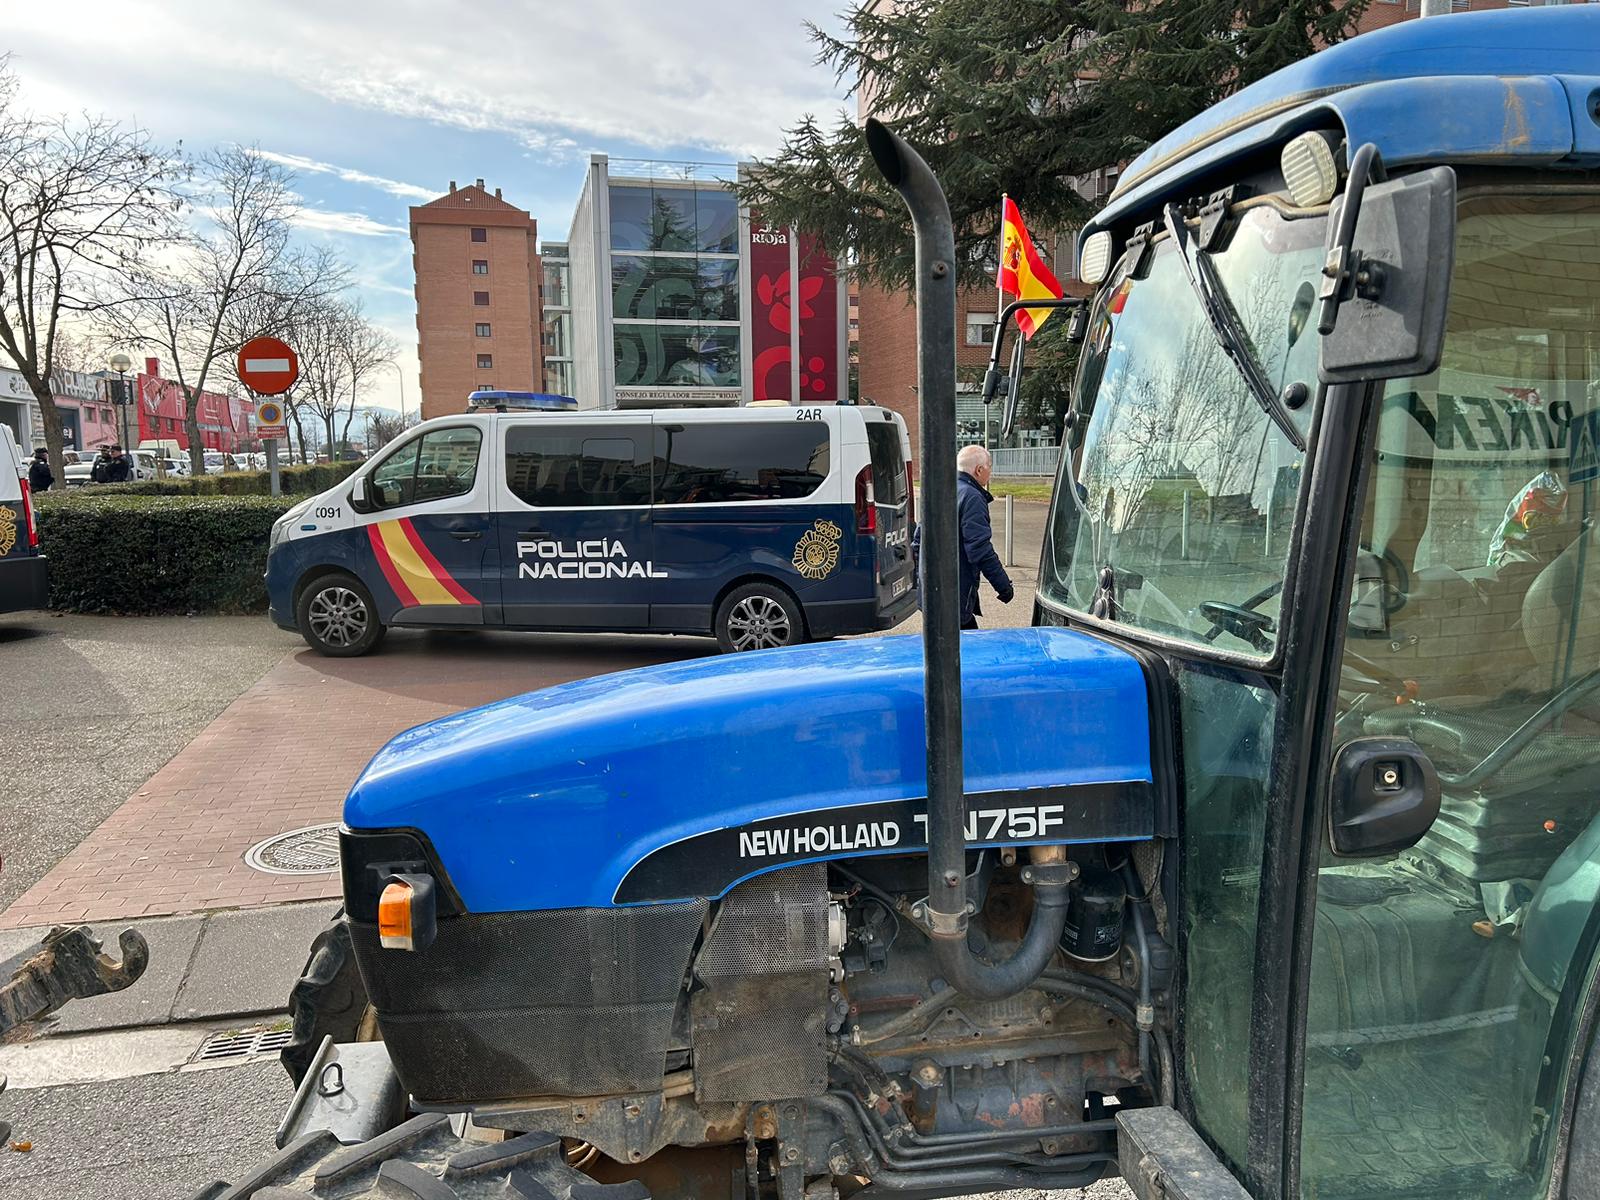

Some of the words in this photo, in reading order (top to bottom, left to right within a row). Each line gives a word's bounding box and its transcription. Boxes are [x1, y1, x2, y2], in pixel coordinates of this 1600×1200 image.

[615, 391, 647, 399] CONSEJO
[649, 391, 690, 399] REGULADOR
[796, 408, 822, 421] 2AR
[516, 537, 628, 558] POLICÍA
[518, 561, 669, 579] NACIONAL
[739, 828, 790, 858] NEW
[793, 821, 901, 854] HOLLAND
